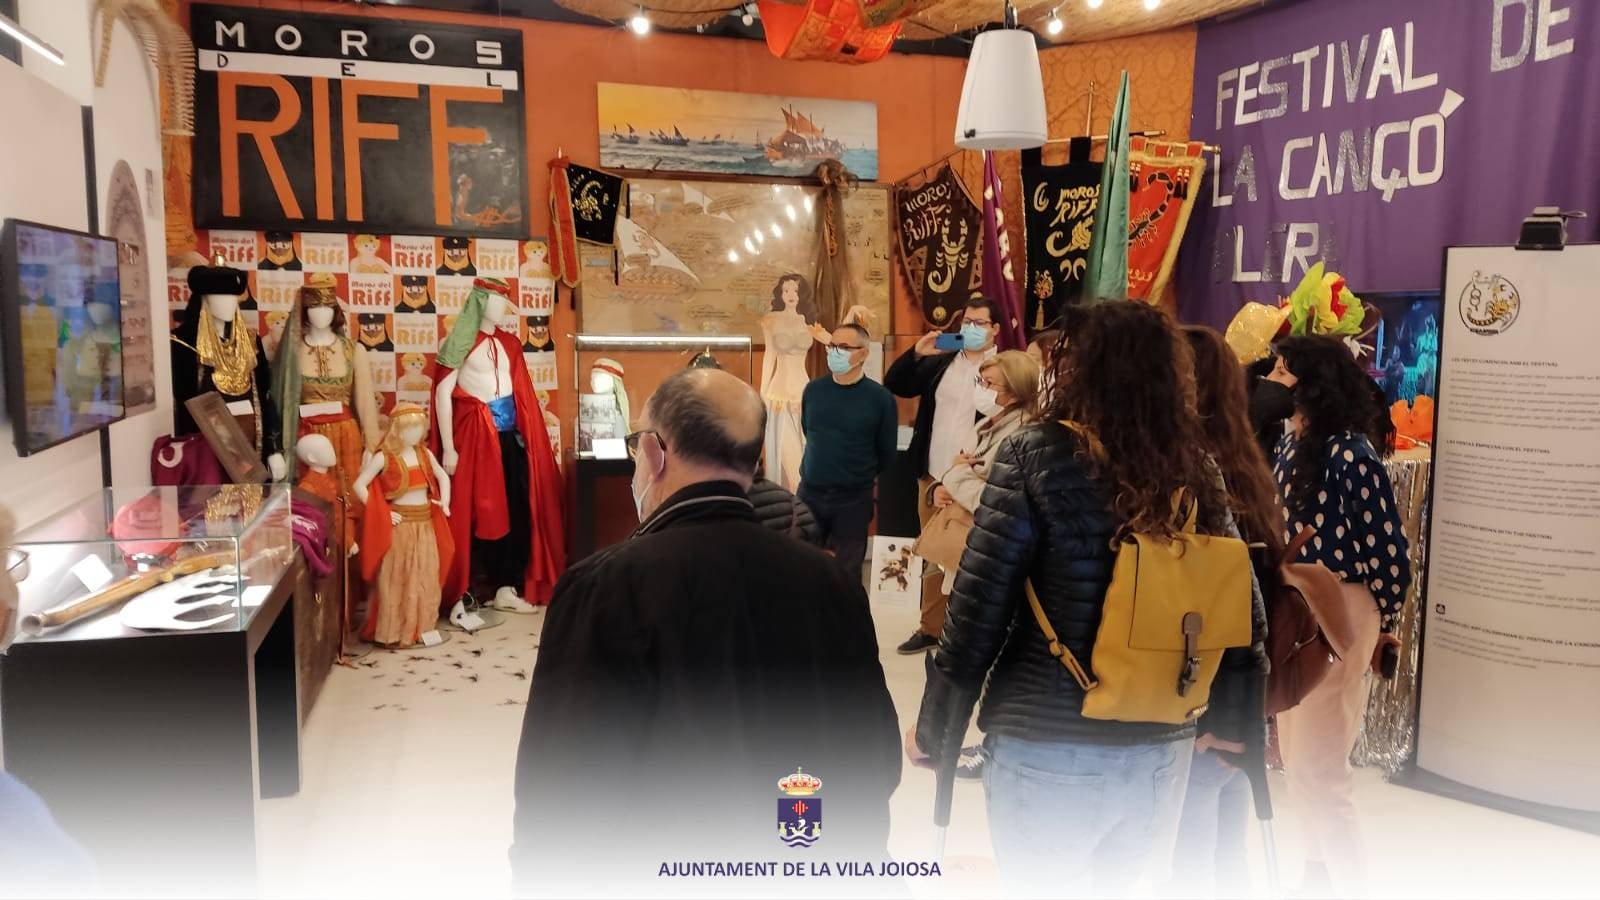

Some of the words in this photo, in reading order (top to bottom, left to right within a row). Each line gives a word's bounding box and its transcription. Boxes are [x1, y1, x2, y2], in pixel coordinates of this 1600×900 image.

[215, 20, 503, 65] MOROS
[216, 53, 503, 88] DEL
[1215, 22, 1439, 130] FESTIVAL
[1491, 0, 1575, 72] DE
[217, 70, 504, 226] RIFF
[1213, 144, 1257, 207] LA
[1279, 88, 1465, 203] CANÇÓ
[305, 248, 344, 265] Riff
[395, 252, 433, 269] Riff
[479, 254, 516, 271] Riff
[168, 285, 190, 302] Ri
[352, 289, 391, 306] Riff
[397, 328, 434, 345] Riff
[370, 367, 393, 383] iff
